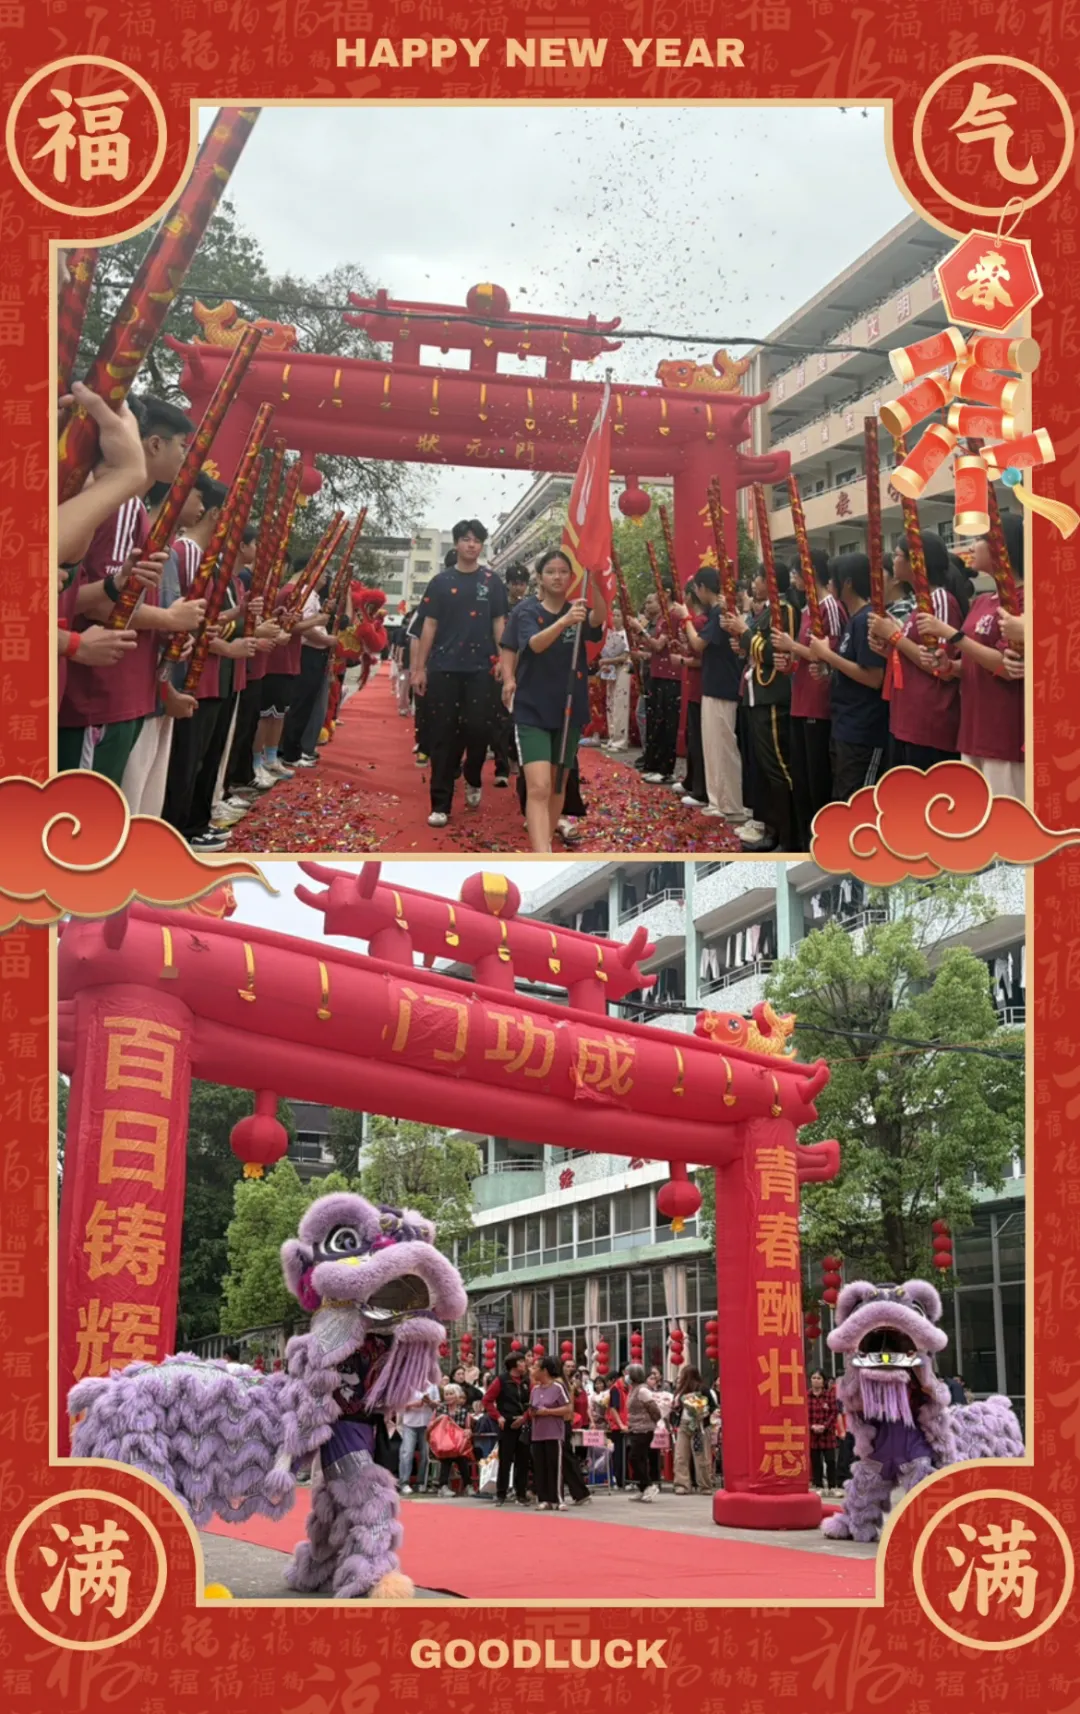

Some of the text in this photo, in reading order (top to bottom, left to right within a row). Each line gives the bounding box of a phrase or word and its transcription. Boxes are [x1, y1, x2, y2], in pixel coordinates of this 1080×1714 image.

[754, 1144, 808, 1478] 青春酬壮志
